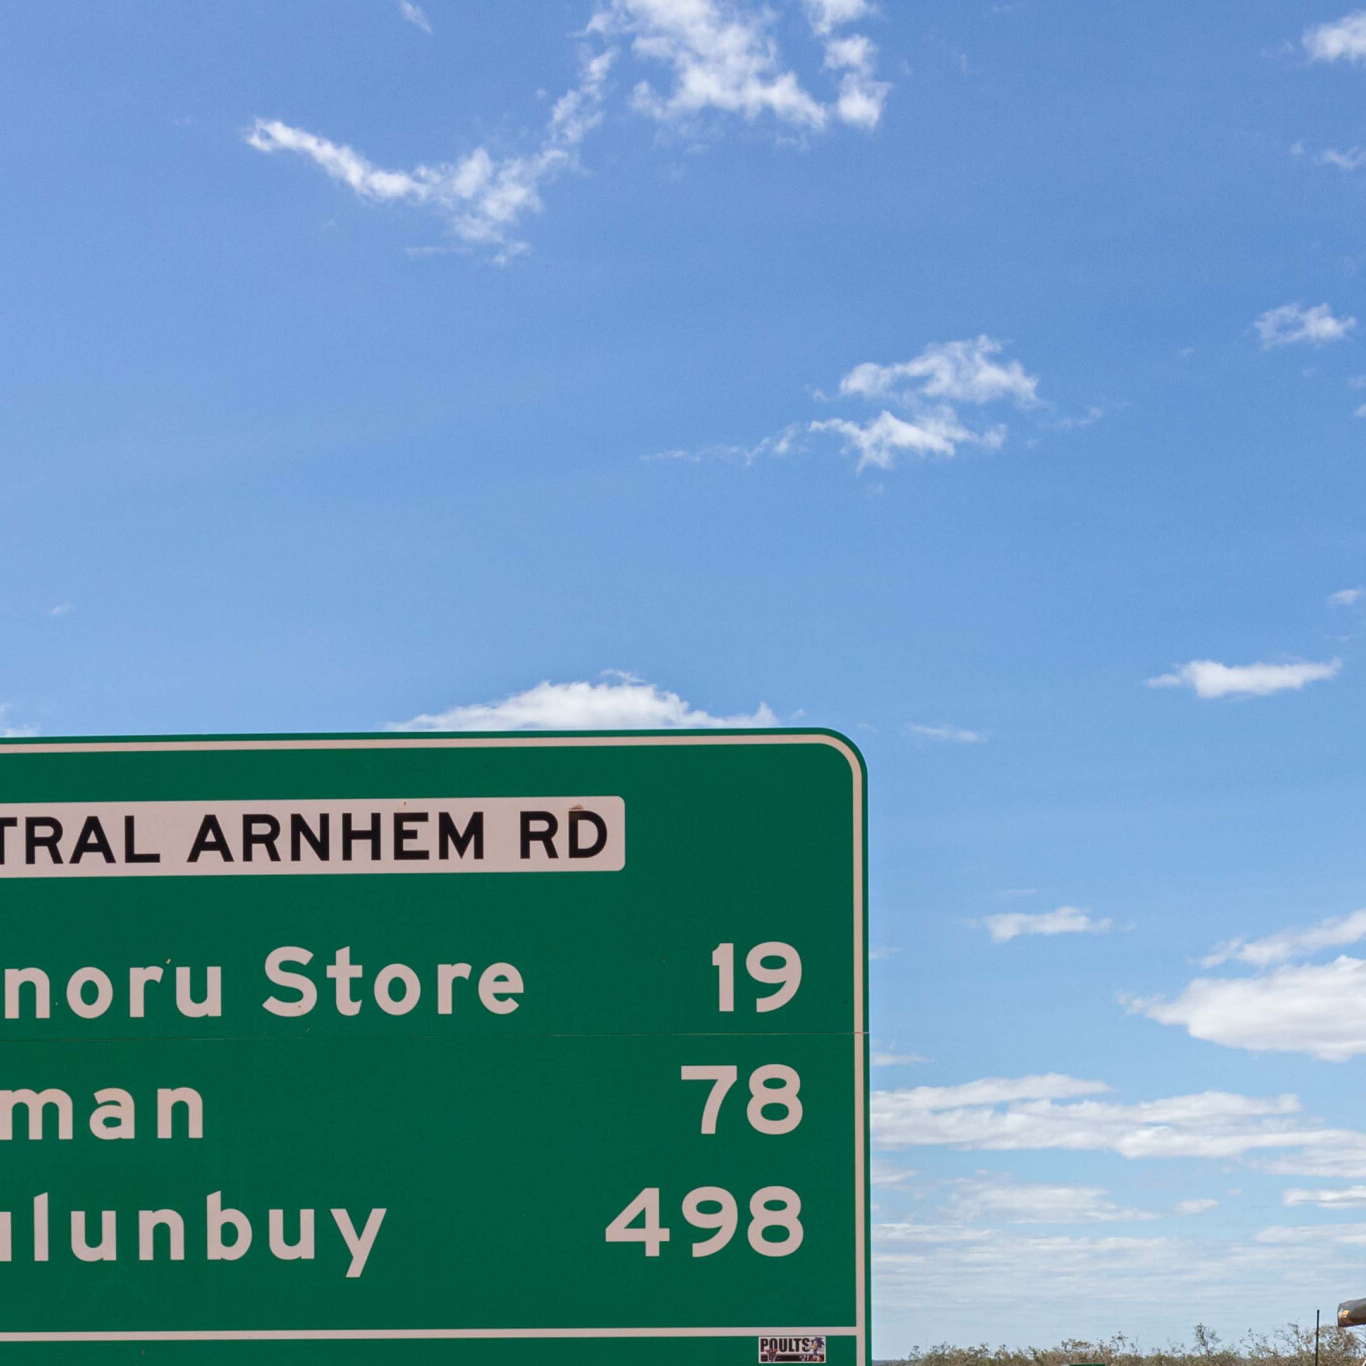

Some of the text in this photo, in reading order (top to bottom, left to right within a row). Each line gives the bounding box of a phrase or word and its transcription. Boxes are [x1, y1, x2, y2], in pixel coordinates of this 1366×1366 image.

[187, 811, 484, 862] ARNHEM
[519, 811, 609, 860] RD
[263, 946, 525, 1018] Store
[711, 942, 803, 1013] 19
[681, 1064, 804, 1135] 78
[605, 1186, 804, 1258] 498
[760, 1338, 811, 1353] POULTS
